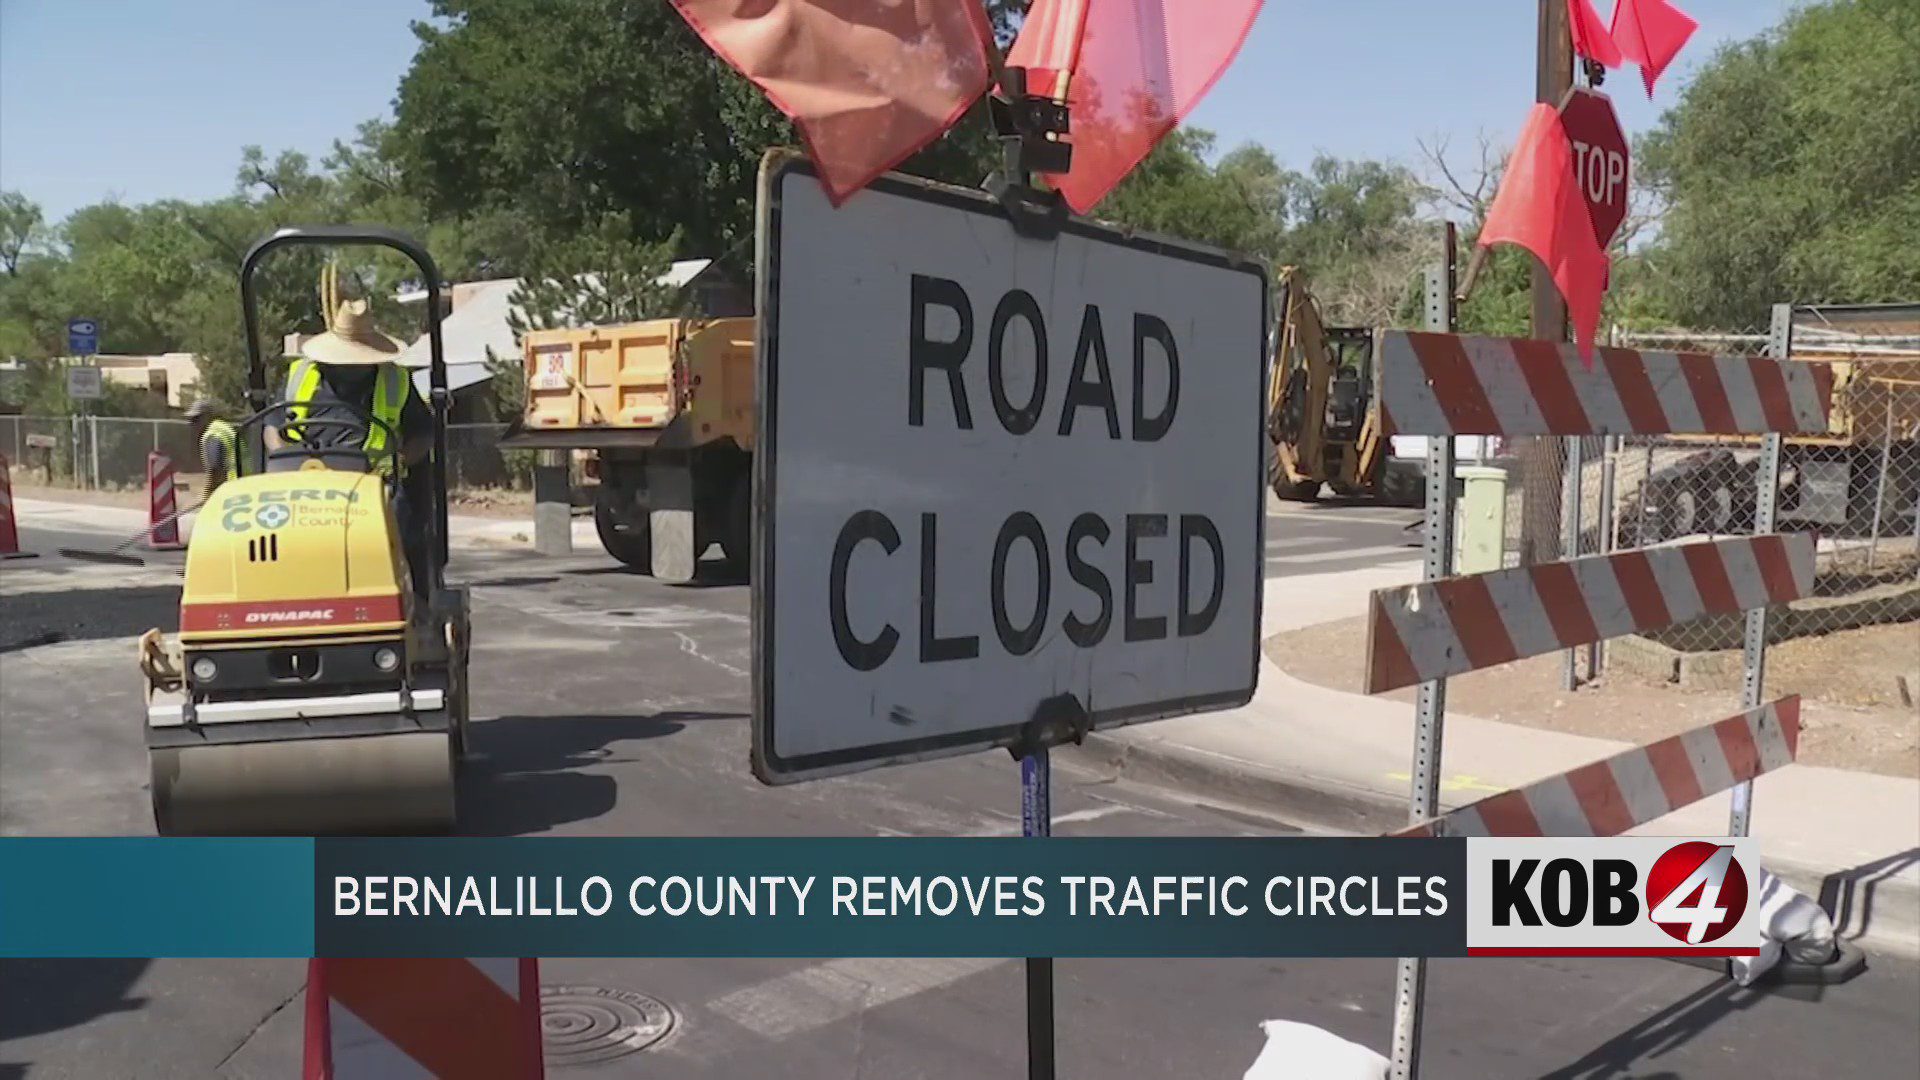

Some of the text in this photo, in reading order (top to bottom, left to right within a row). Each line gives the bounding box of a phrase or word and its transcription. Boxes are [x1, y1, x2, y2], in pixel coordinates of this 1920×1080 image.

[1572, 140, 1625, 207] TOP
[907, 272, 1181, 443] ROAD
[222, 488, 359, 511] BERN
[222, 503, 291, 532] CO
[298, 516, 355, 528] County
[829, 508, 1225, 672] CLOSED
[244, 608, 336, 623] DYNAPAC
